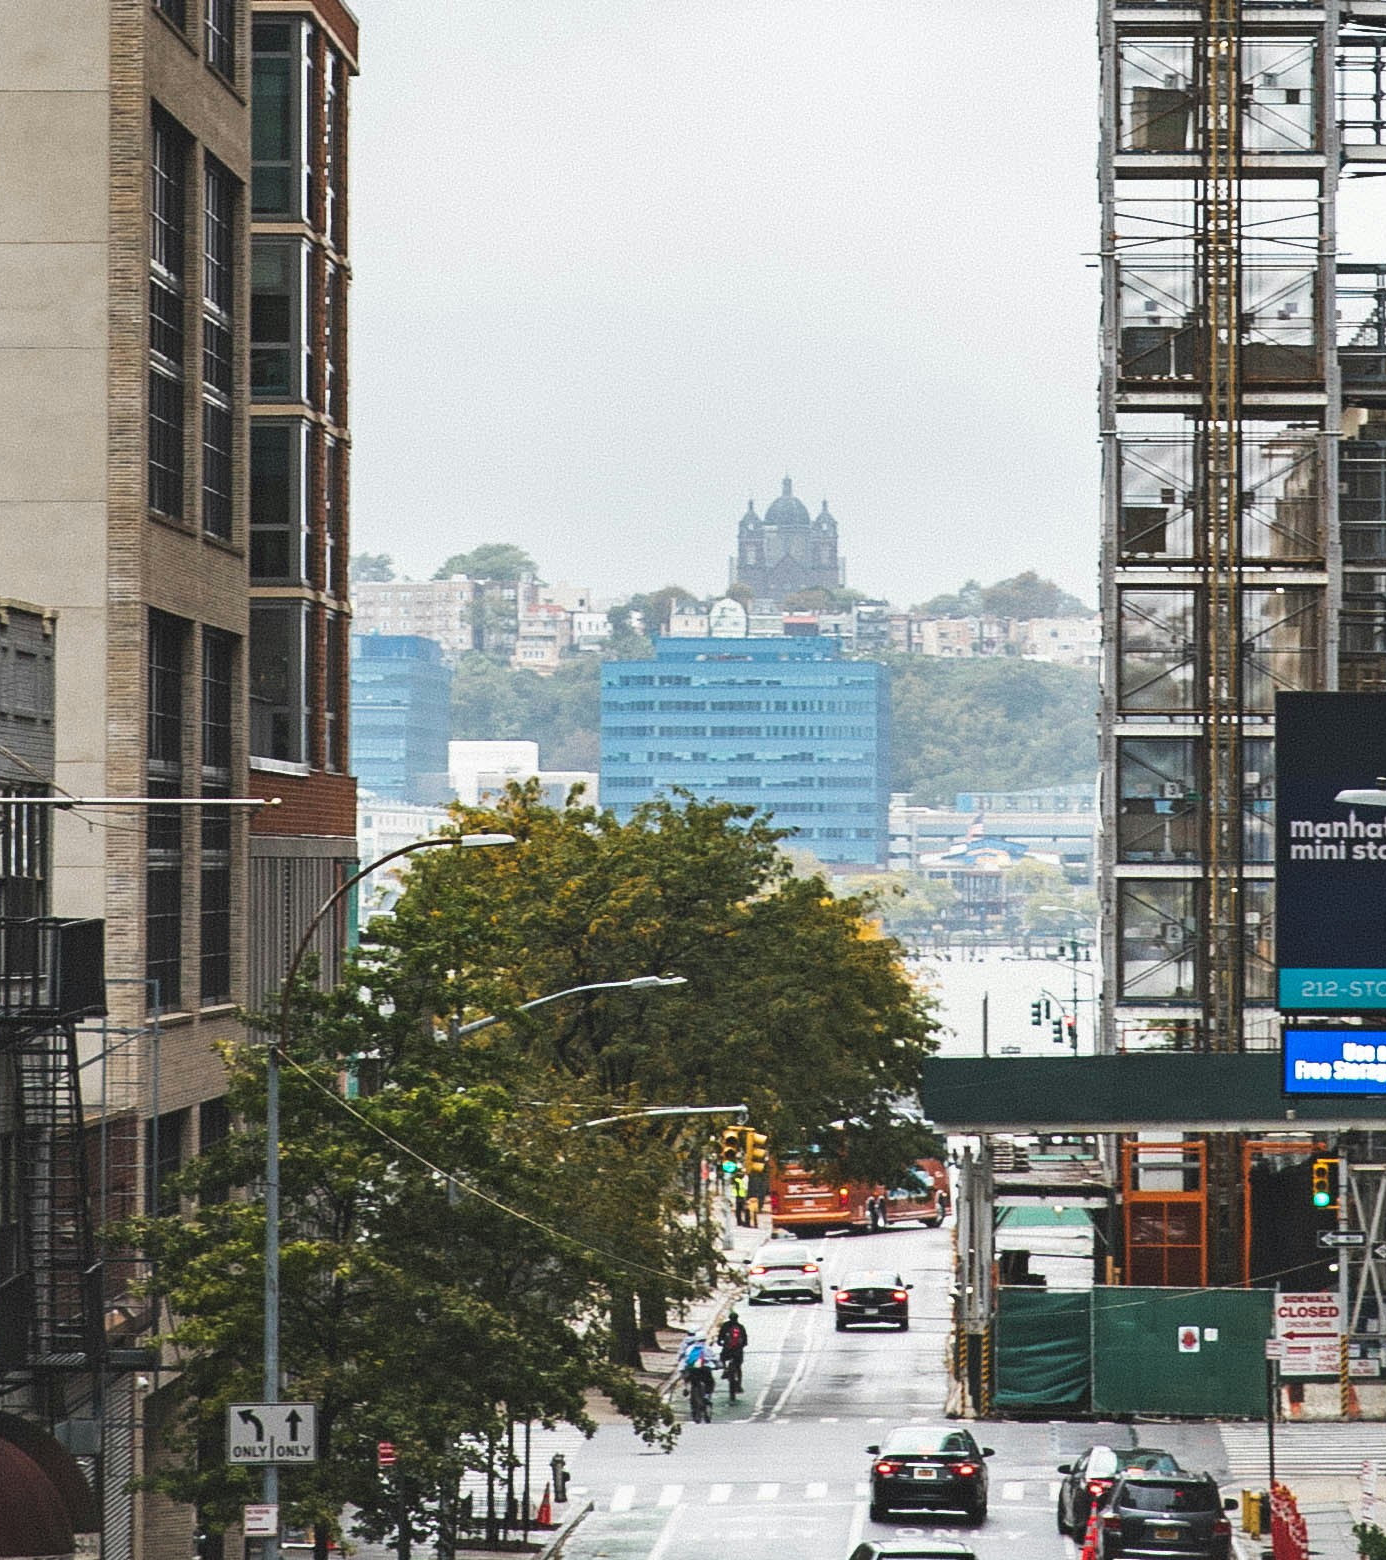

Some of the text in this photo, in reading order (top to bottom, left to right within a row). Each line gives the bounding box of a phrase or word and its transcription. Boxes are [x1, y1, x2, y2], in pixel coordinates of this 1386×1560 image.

[1290, 839, 1346, 860] mini
[1278, 1307, 1340, 1318] CLOSED
[233, 1445, 267, 1458] ONLY
[276, 1445, 310, 1457] ONLY
